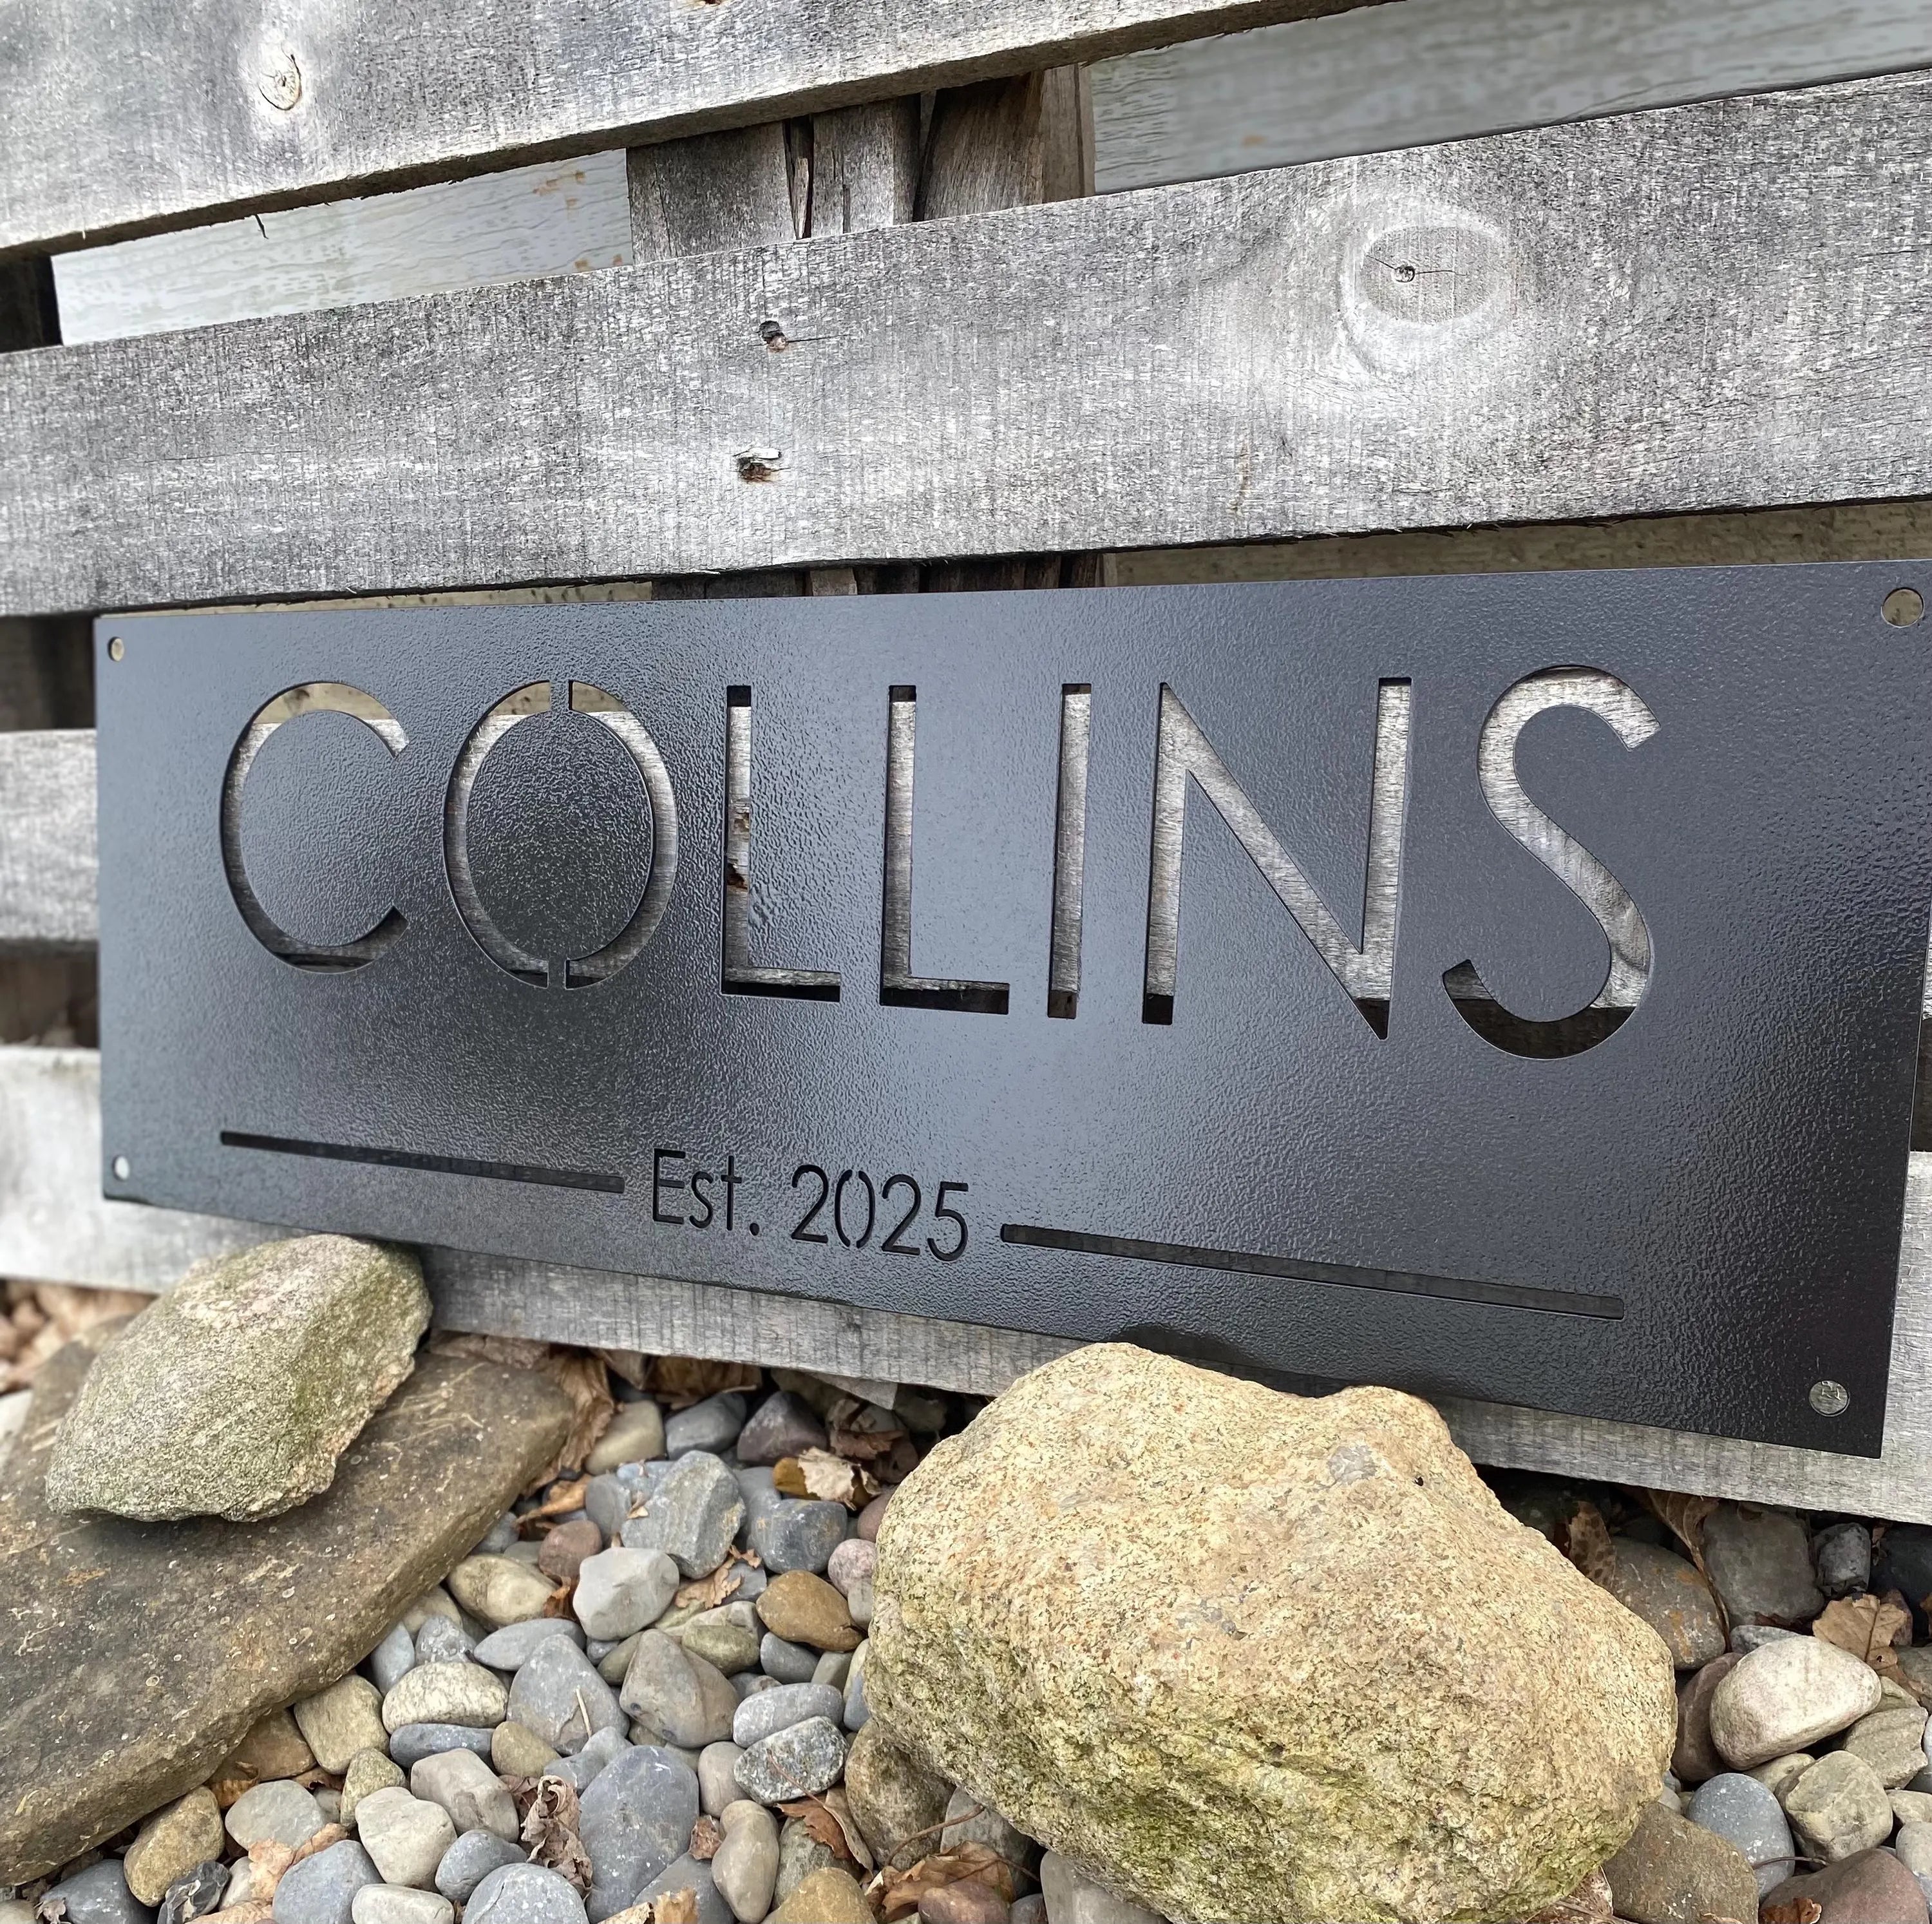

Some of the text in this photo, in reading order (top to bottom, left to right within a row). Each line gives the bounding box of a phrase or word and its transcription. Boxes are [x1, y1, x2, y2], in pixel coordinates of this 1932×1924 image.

[220, 665, 1662, 1060] COLLINS
[652, 1148, 969, 1262] Est. 2025
